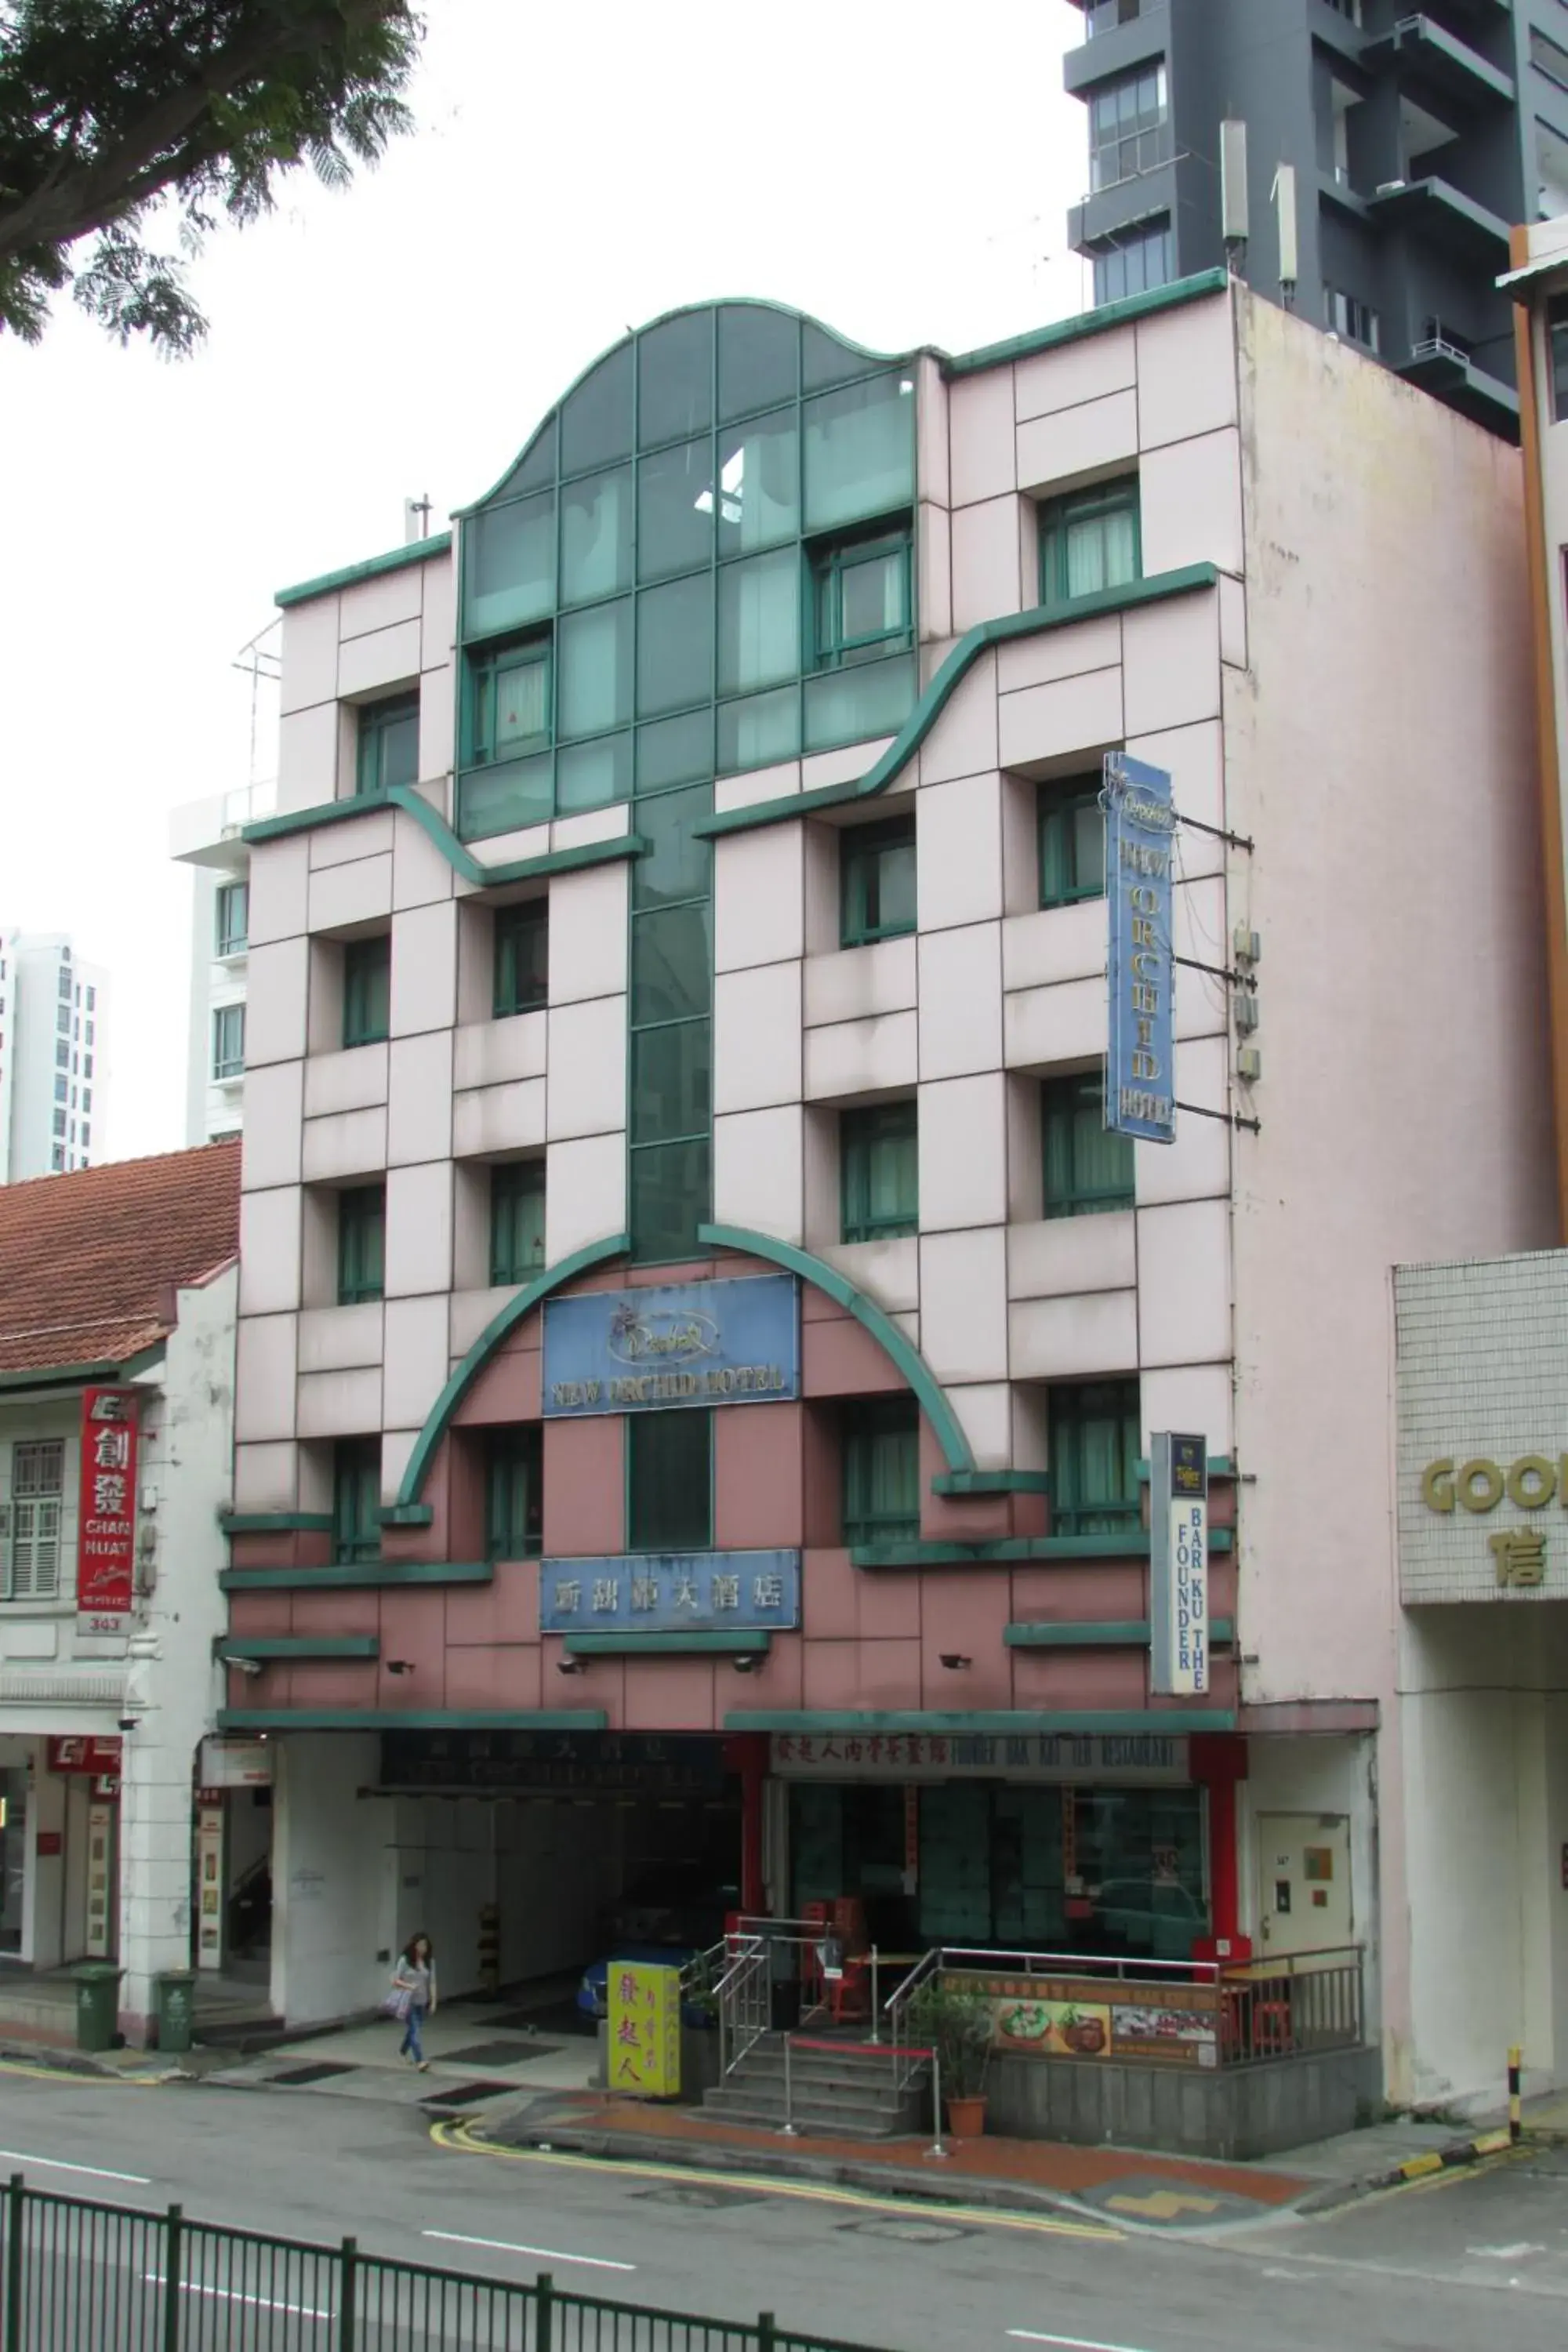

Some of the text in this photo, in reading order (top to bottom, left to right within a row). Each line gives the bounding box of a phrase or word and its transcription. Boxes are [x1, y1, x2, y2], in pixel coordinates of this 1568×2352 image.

[1131, 886, 1161, 1080] ORCHID
[552, 1363, 784, 1406] NEW ORCHID HOTEL
[1421, 1453, 1568, 1515] GOO
[85, 1519, 131, 1534] CHAN
[1487, 1524, 1548, 1588] 信
[1177, 1523, 1190, 1670] FOUNDER
